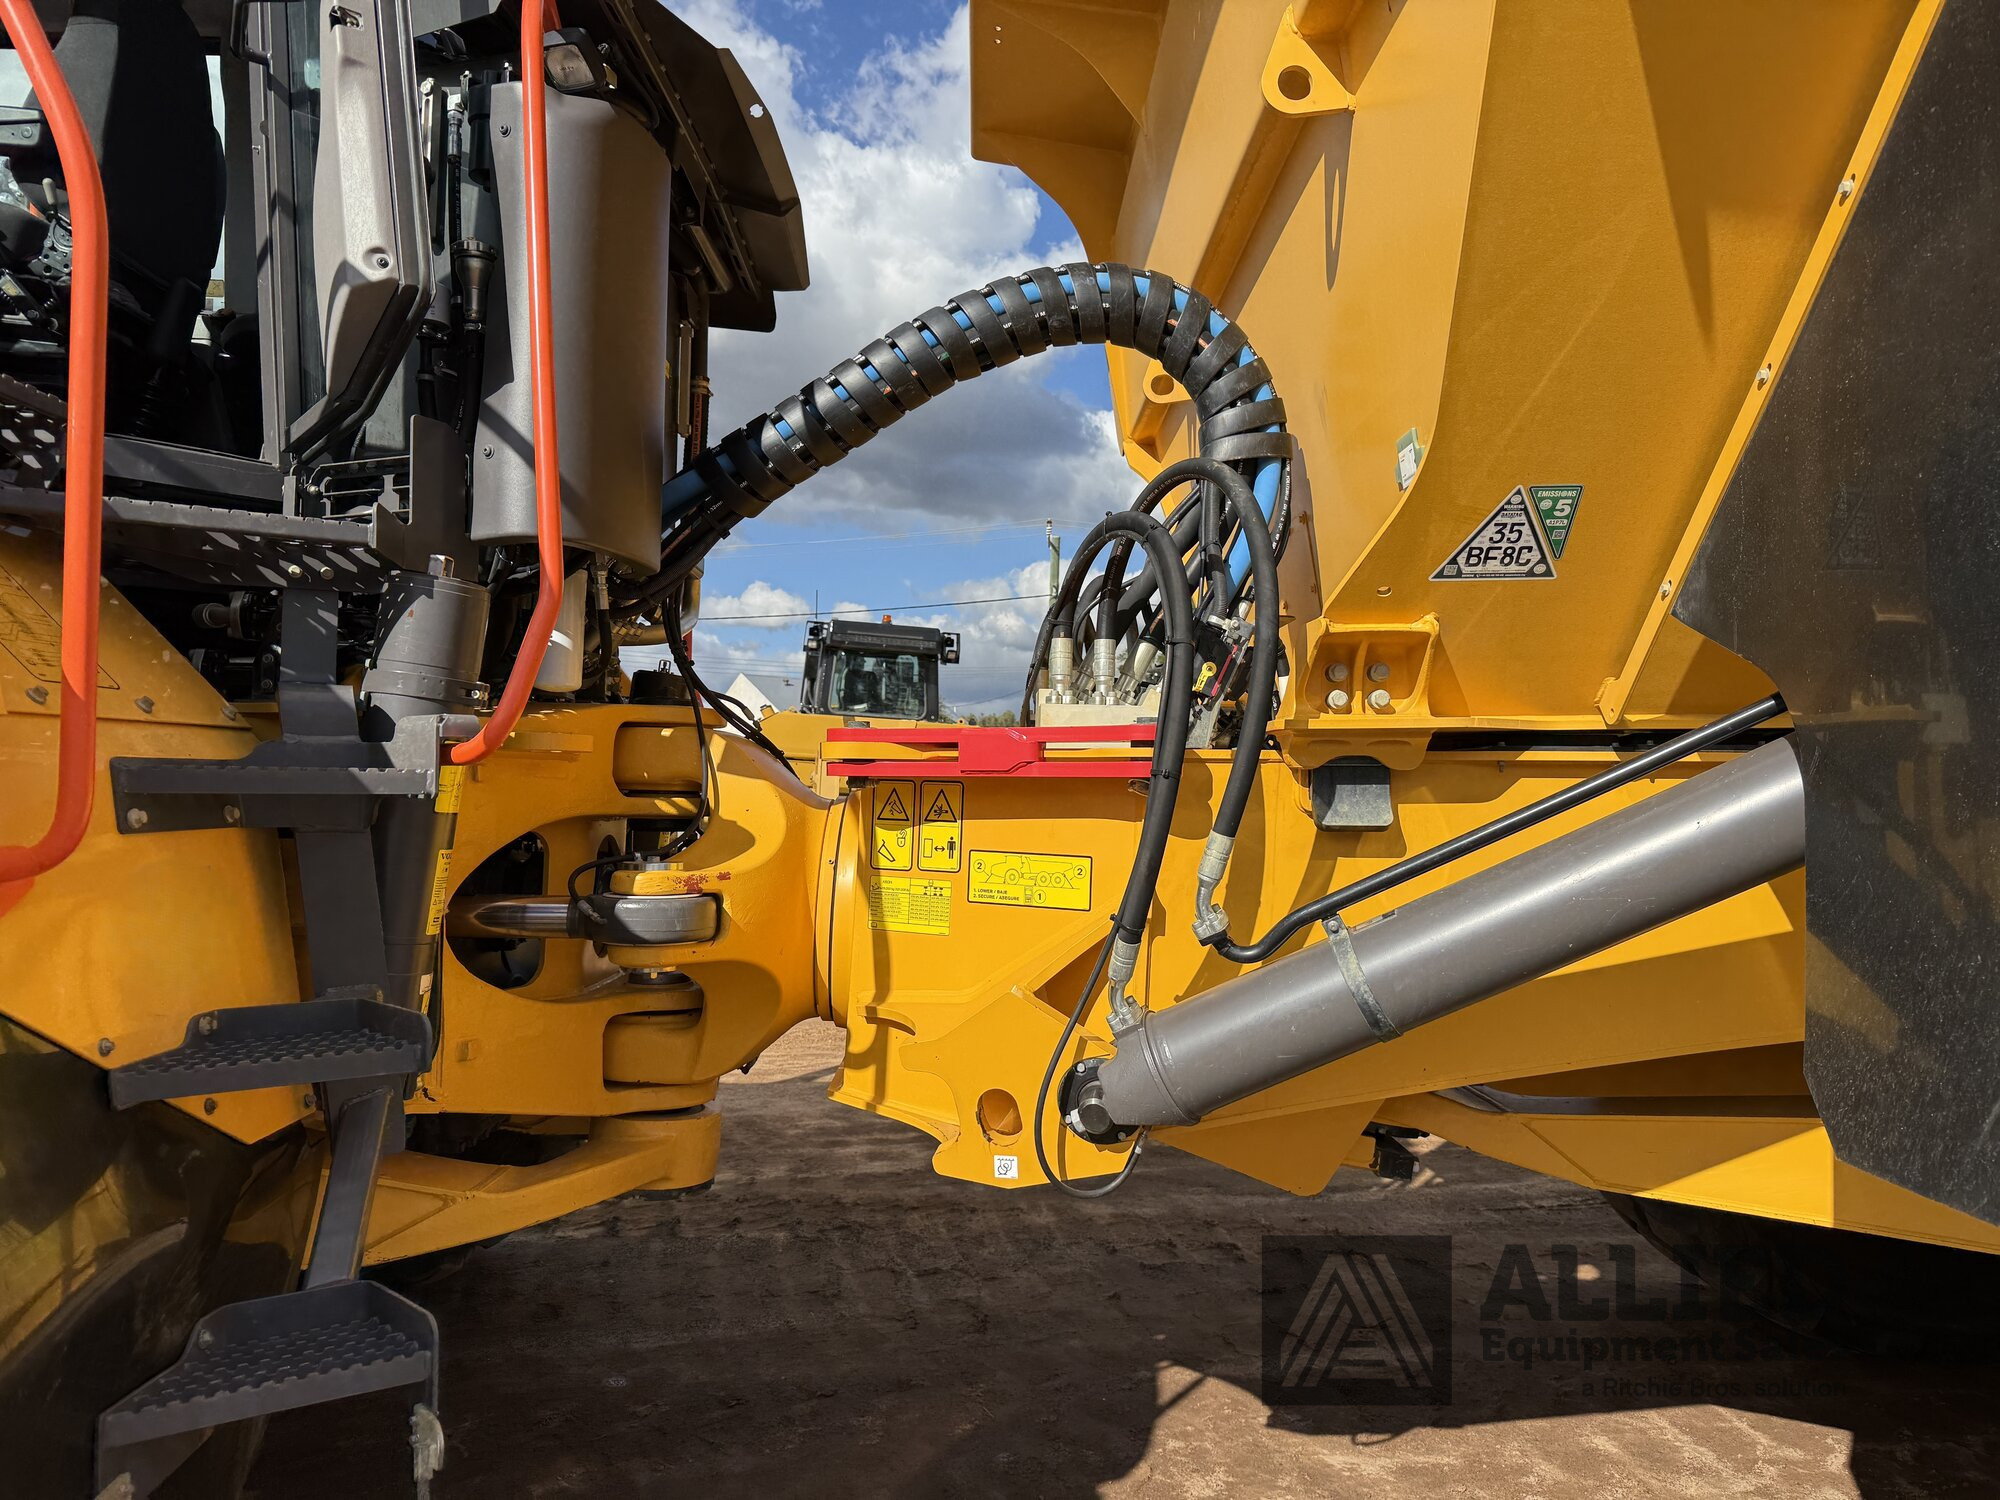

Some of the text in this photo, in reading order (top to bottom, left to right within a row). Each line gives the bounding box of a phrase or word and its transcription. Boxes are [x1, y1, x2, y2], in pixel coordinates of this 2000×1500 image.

[1537, 490, 1577, 498] EMISSIONS
[1553, 499, 1572, 516] 5
[1488, 522, 1526, 544] 35
[1464, 546, 1534, 567] BF8C
[976, 862, 983, 870] 2
[1076, 868, 1083, 876] 2
